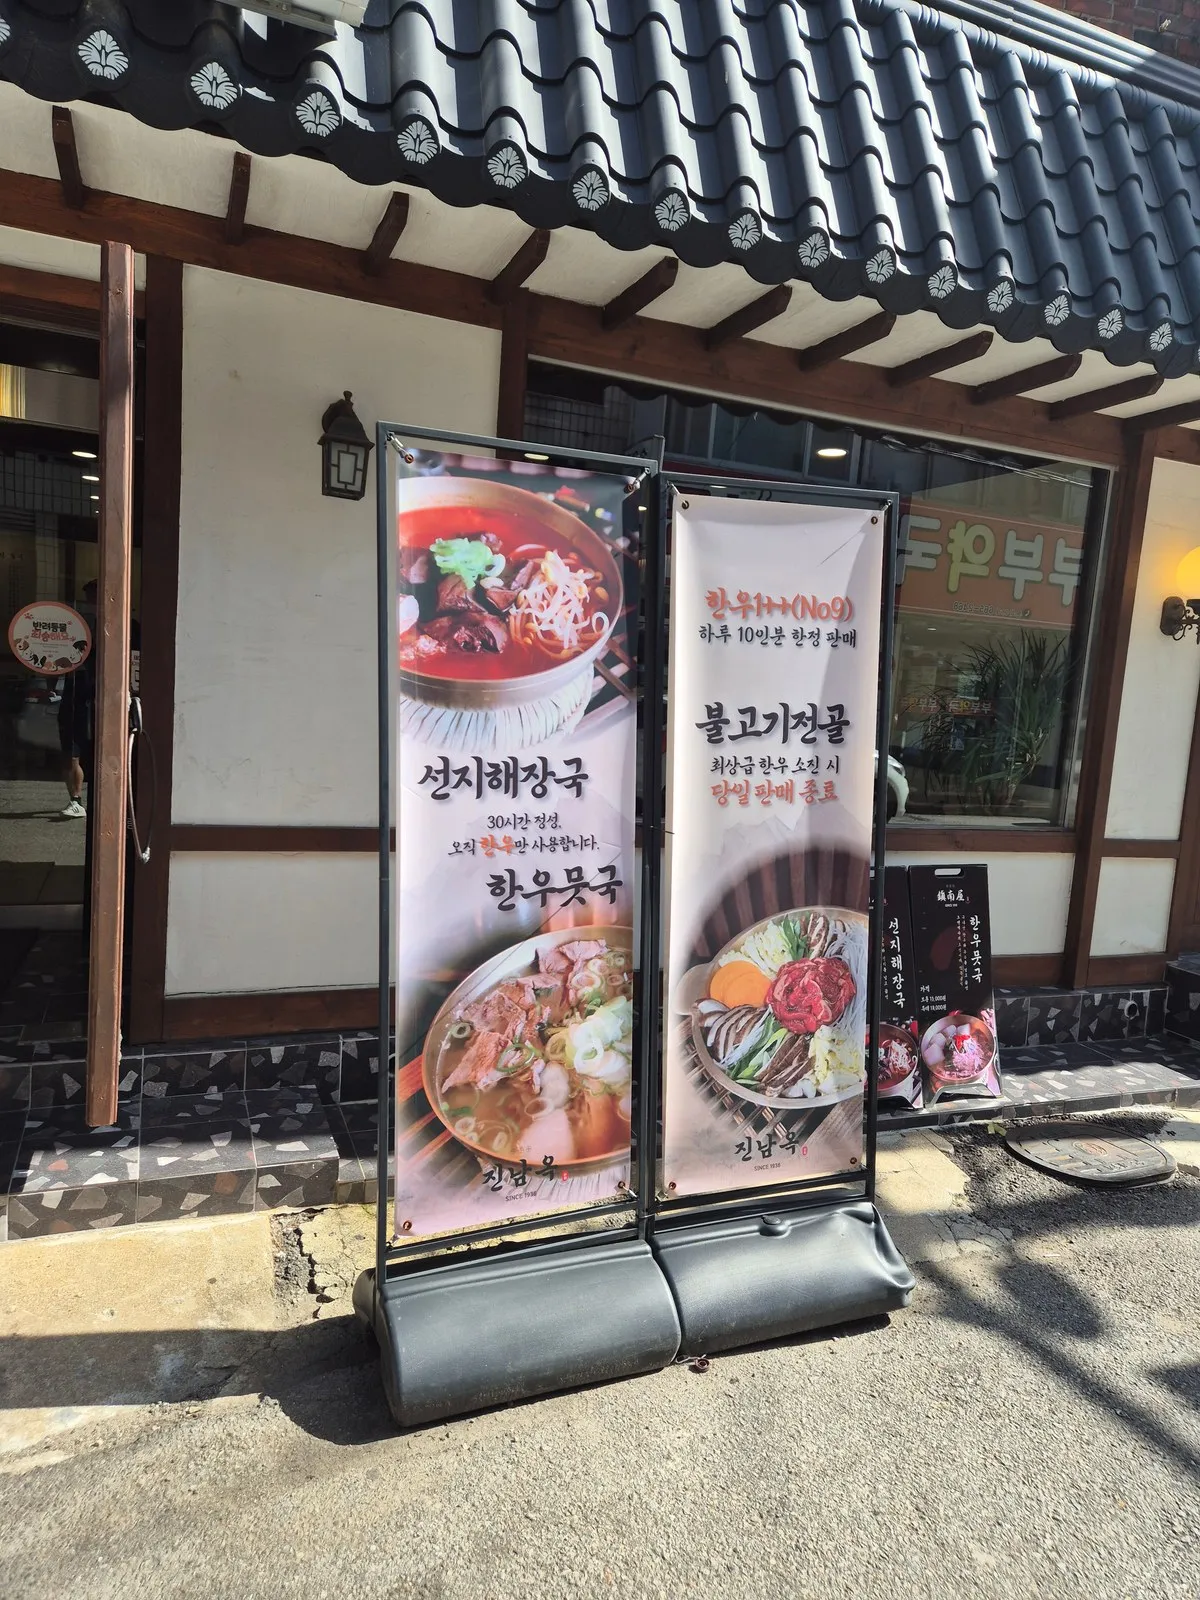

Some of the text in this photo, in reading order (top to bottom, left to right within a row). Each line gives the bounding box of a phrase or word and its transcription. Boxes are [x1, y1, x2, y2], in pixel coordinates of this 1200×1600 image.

[33, 621, 67, 632] 반려동물
[699, 623, 857, 648] 하루 10인분 한정 판매
[695, 701, 851, 744] 불고기전골
[418, 756, 589, 800] 선지해장국
[710, 755, 840, 775] 최상급 한우 소진 시
[711, 779, 839, 806] 당일 판매 종료
[487, 812, 562, 830] 30시간 정성.
[448, 834, 600, 858] 오직 한우만 사용합니다.
[889, 918, 906, 1009] 선지해장국
[734, 1131, 799, 1161] 진남옥
[482, 1155, 558, 1192] 진남옥
[505, 1192, 523, 1201] SINCE
